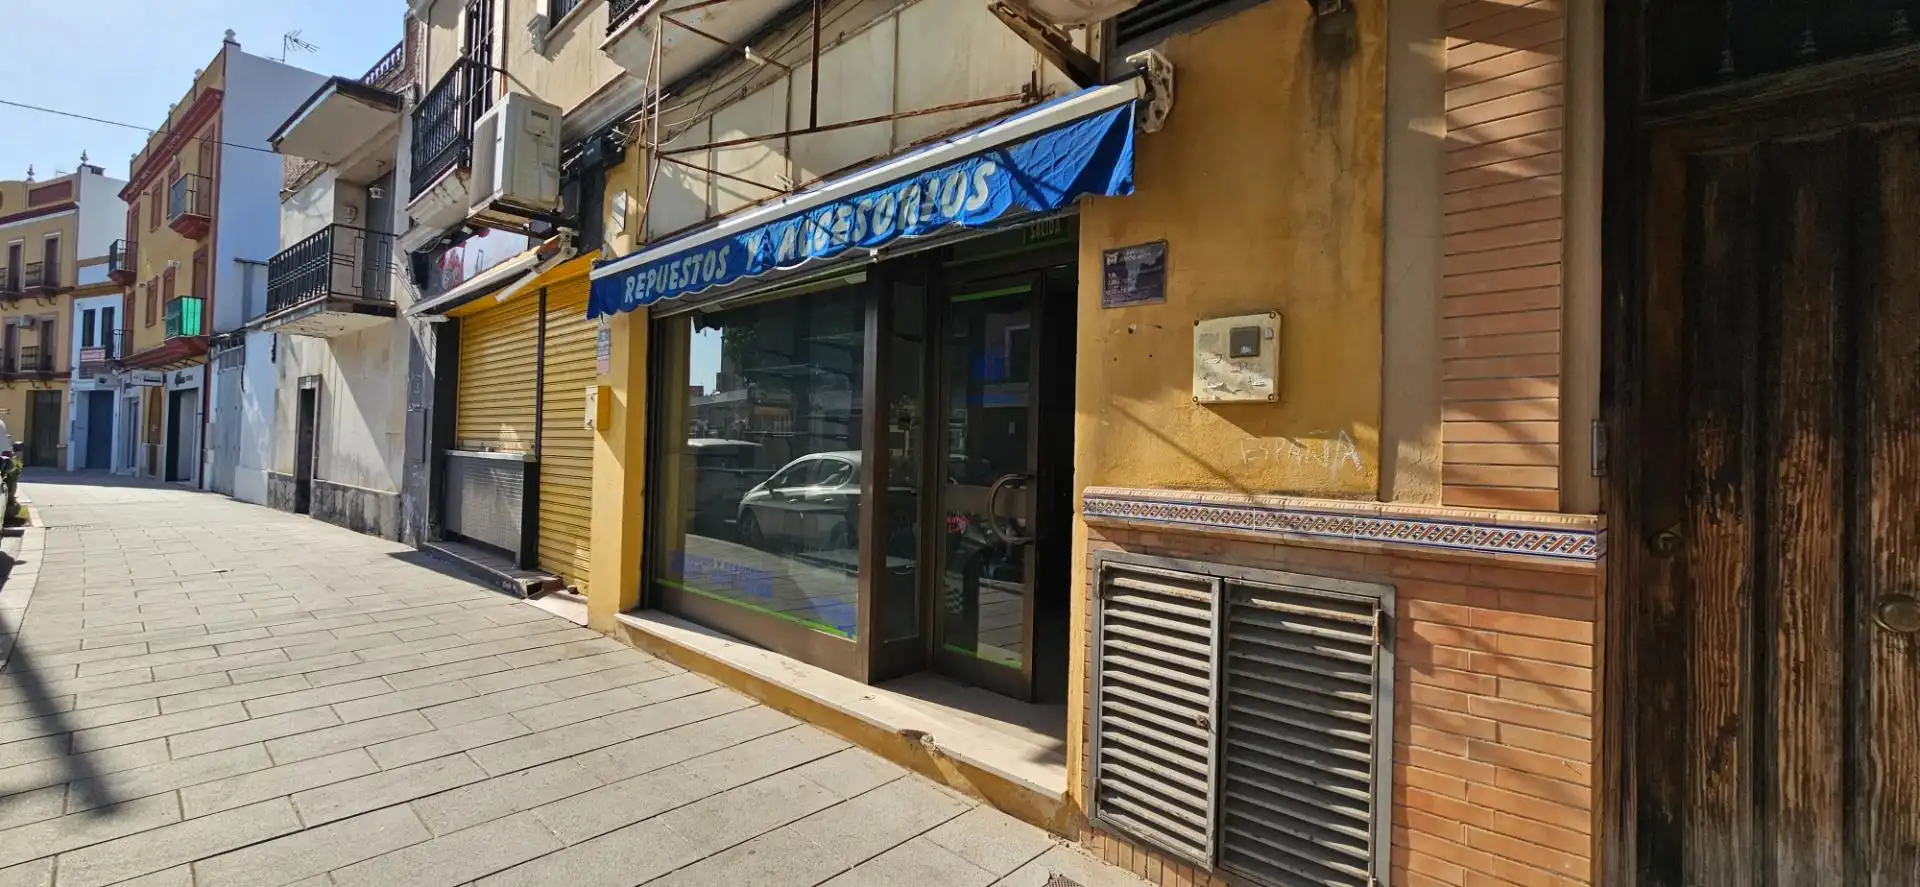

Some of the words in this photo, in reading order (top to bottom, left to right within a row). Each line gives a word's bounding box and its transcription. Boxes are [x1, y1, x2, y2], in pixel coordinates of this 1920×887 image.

[624, 244, 731, 304] REPUESTOS
[745, 233, 763, 272] Y
[778, 160, 996, 263] ACCESORIOS
[1030, 217, 1062, 241] SALIDA
